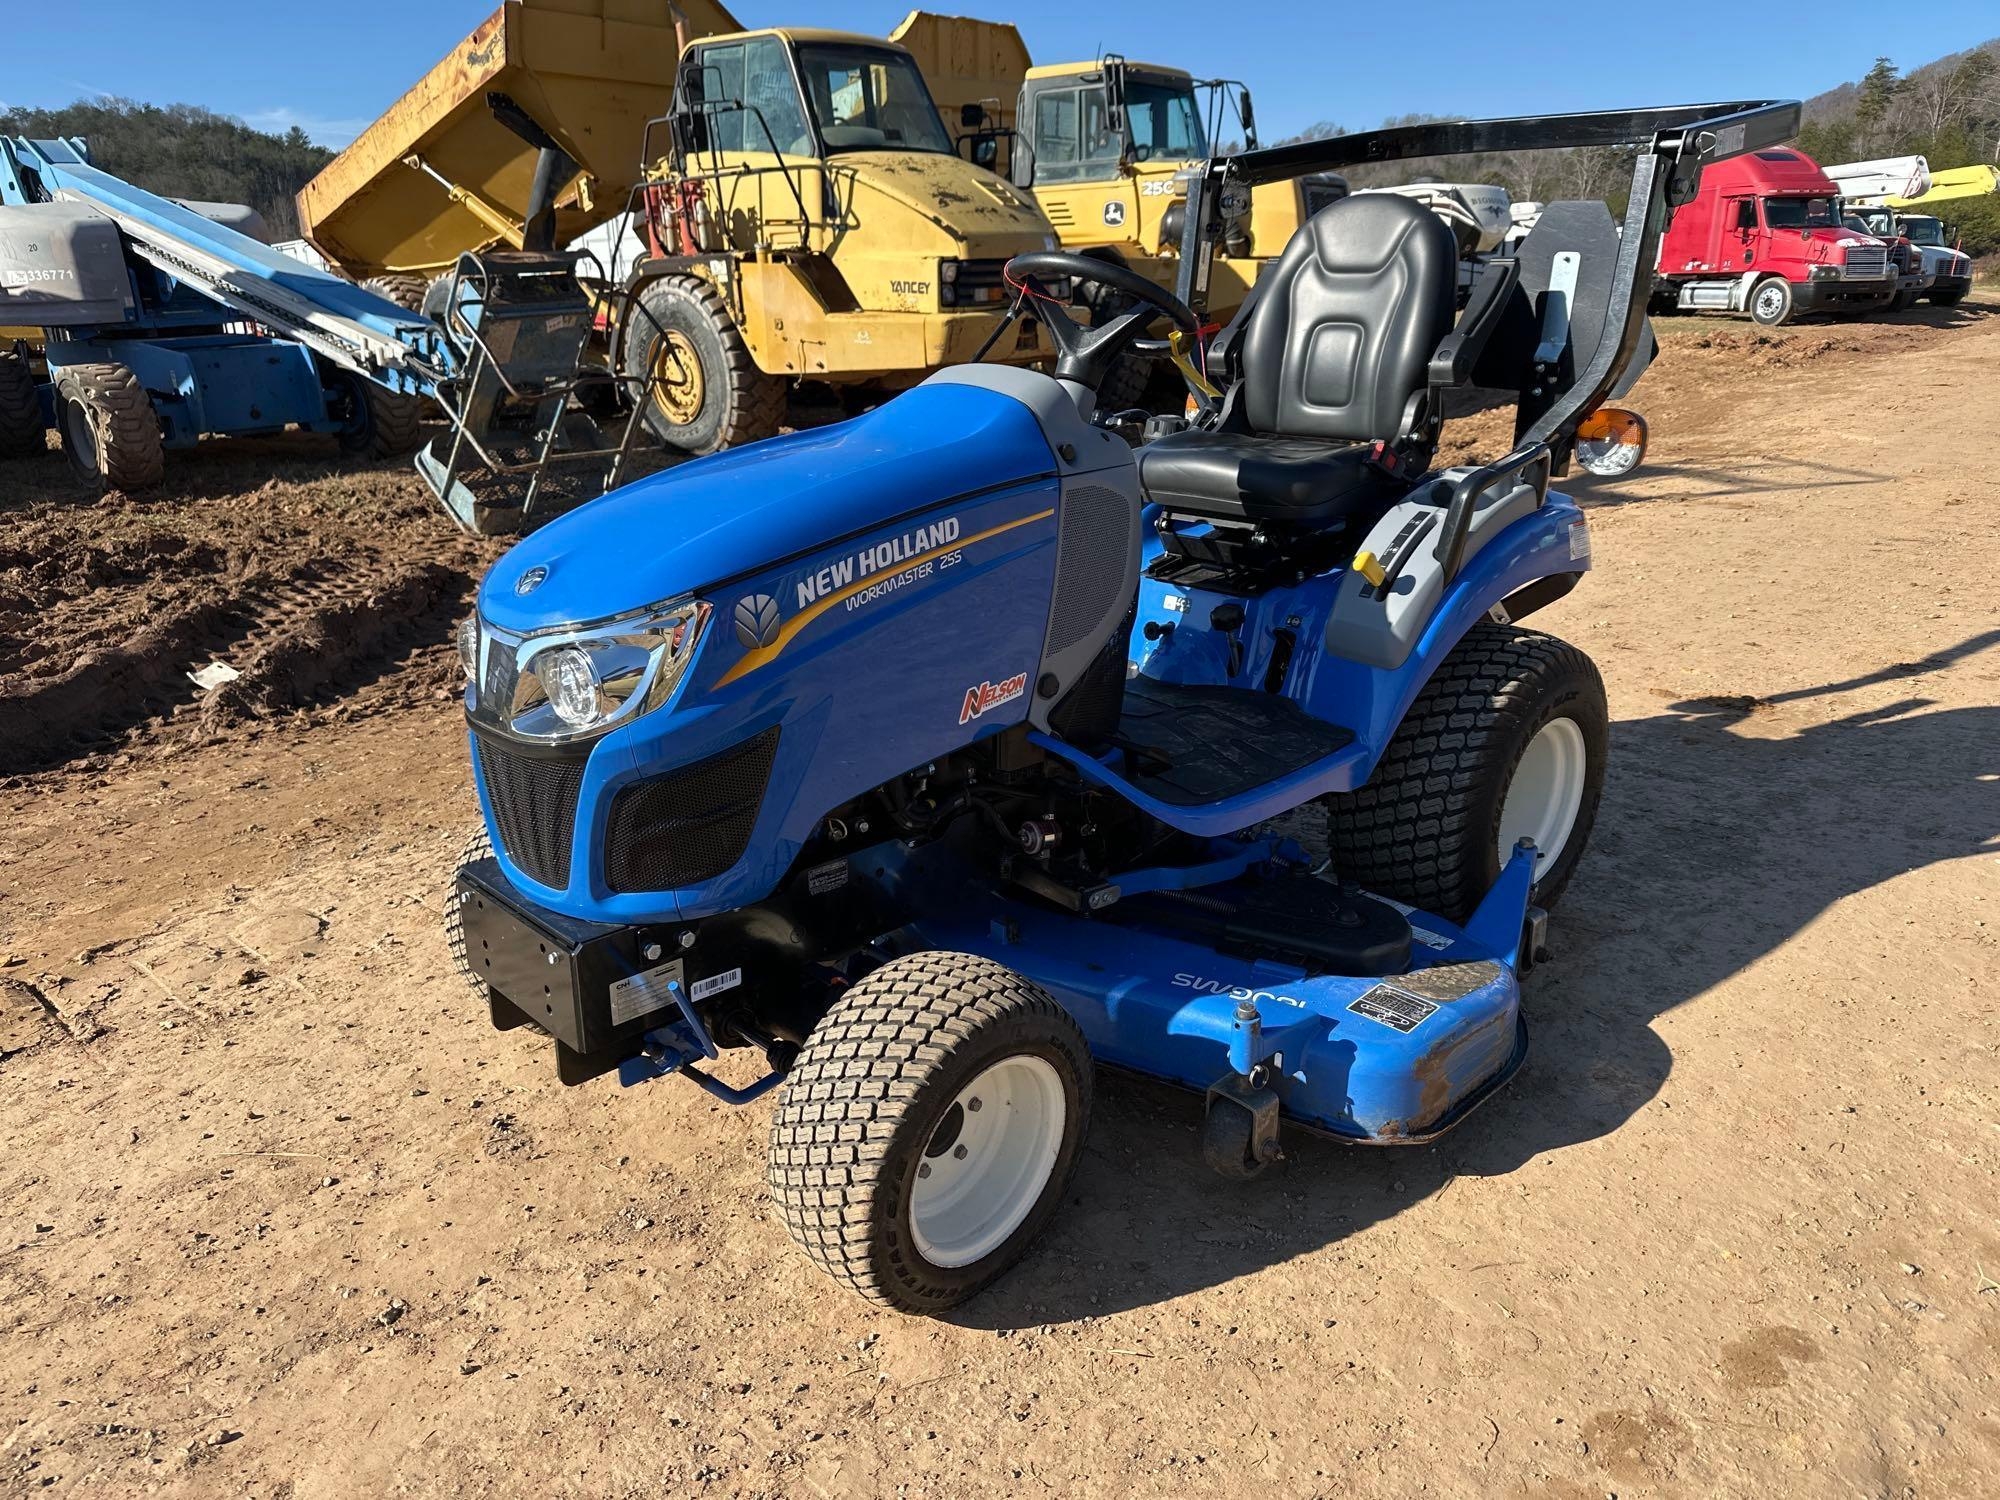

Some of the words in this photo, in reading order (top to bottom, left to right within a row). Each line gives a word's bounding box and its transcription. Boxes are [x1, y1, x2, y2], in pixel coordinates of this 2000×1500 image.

[28, 243, 38, 252] 20
[27, 269, 74, 281] 336771
[890, 280, 931, 294] YANCEY
[797, 556, 854, 609] NEW
[858, 517, 960, 577] HOLLAND
[845, 561, 933, 612] WORKMASTER
